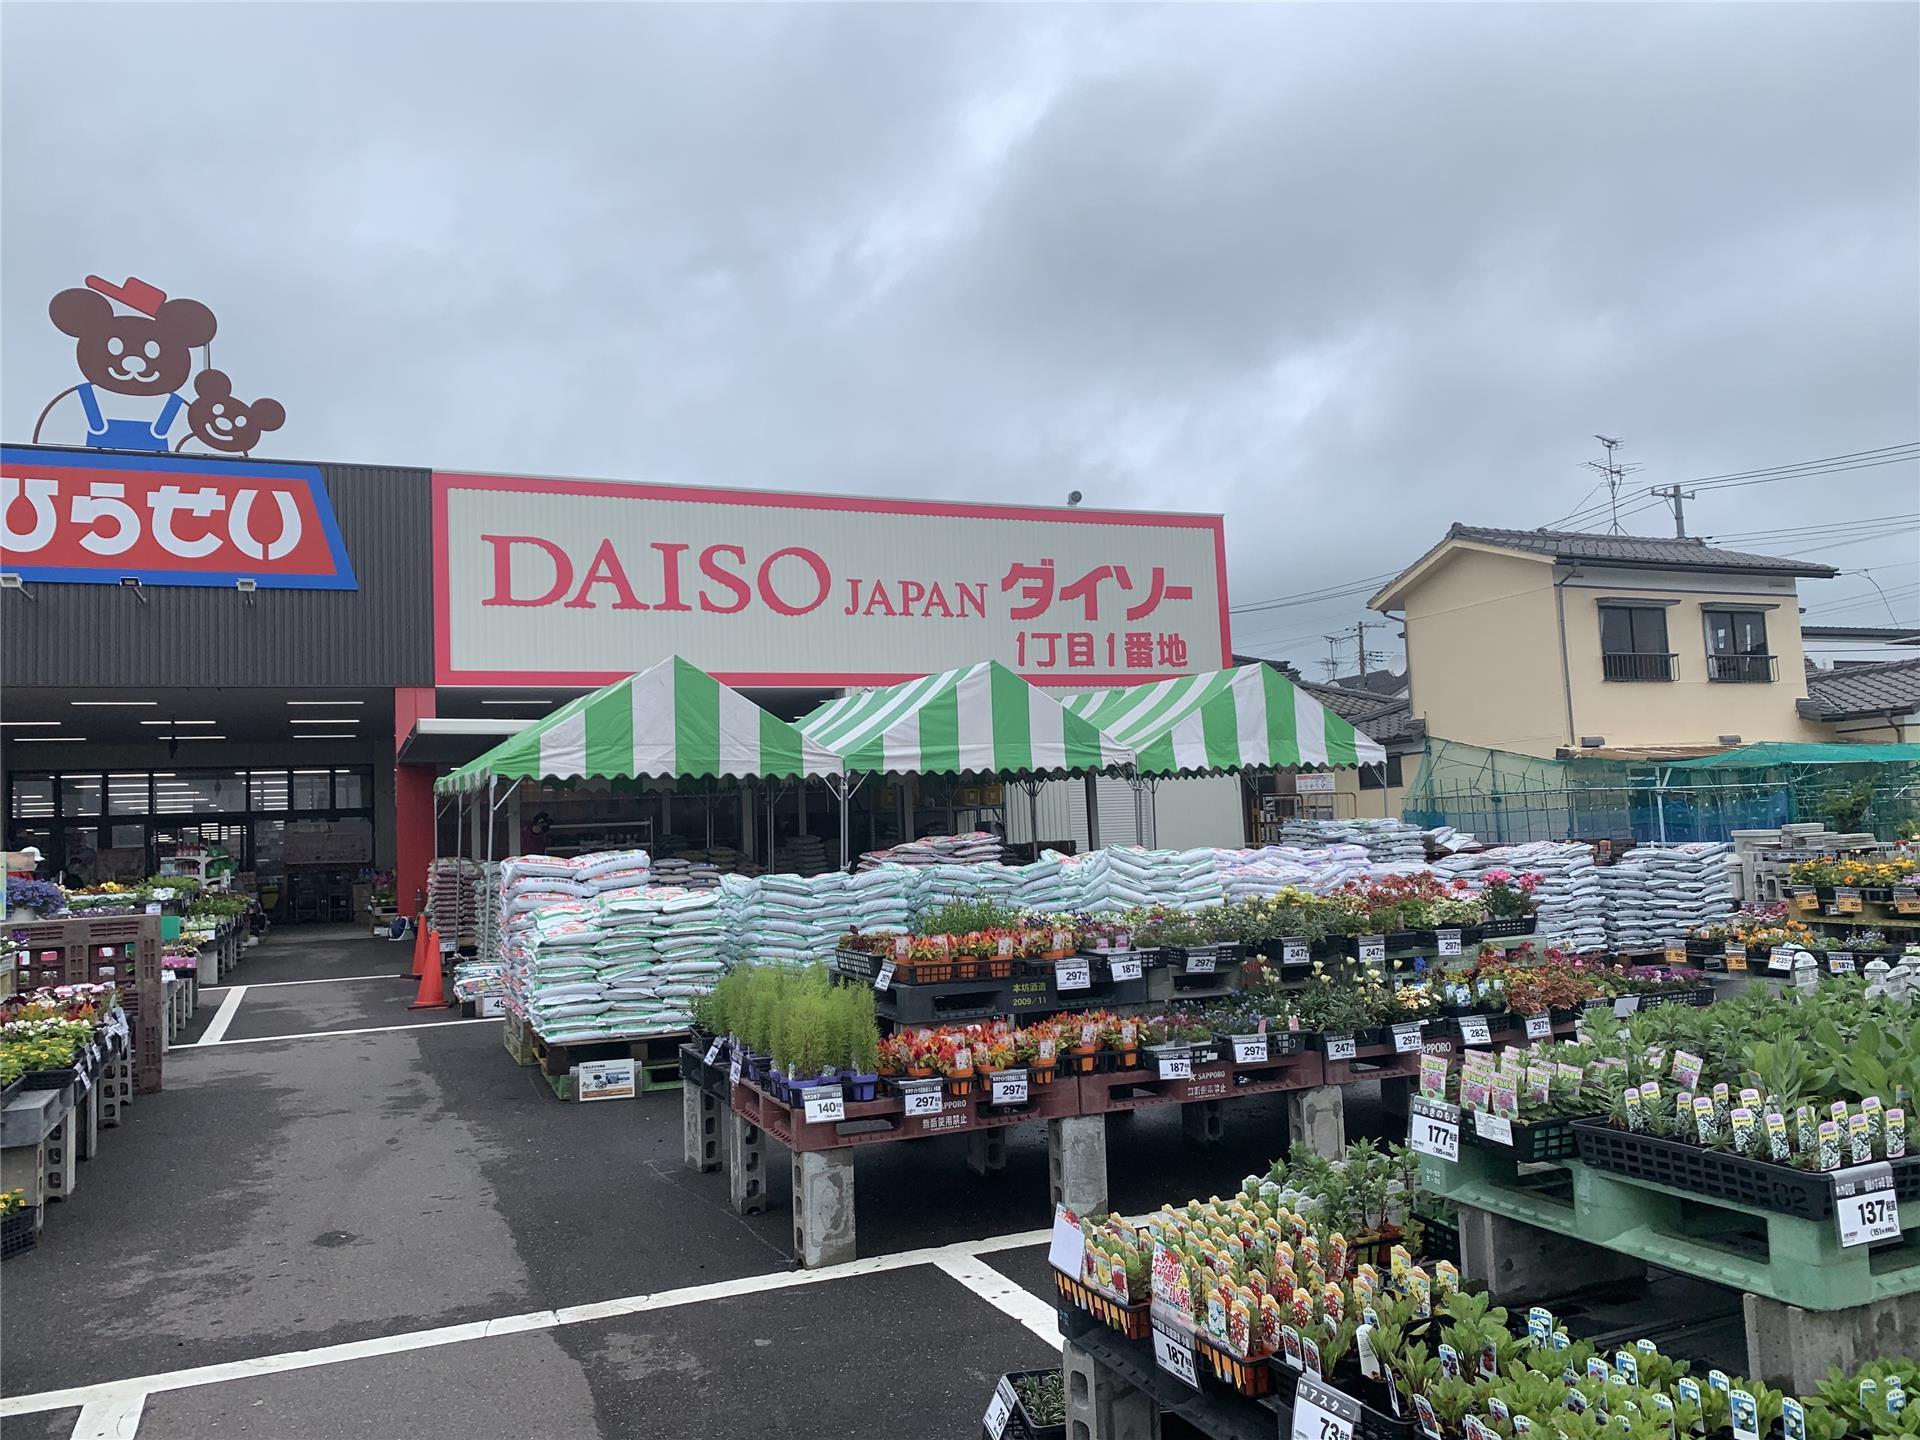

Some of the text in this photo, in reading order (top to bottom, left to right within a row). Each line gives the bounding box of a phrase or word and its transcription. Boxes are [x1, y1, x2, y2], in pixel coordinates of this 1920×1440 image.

[0, 478, 302, 561] ひらせい
[481, 534, 1193, 622] DAISO JAPAN ダイソー
[1017, 631, 1188, 668] 1丁目1番地
[1291, 948, 1304, 957] 247
[1366, 948, 1380, 956] 247
[1195, 958, 1210, 967] 297
[1122, 964, 1135, 973] 187
[1066, 971, 1082, 981] 297
[1533, 1021, 1545, 1030] 297
[1470, 1028, 1484, 1038] 282
[1402, 1035, 1417, 1045] 297
[1244, 1046, 1260, 1056] 297
[1335, 1043, 1350, 1053] 247
[1169, 1063, 1184, 1073] 187
[1198, 1071, 1226, 1081] SAPPORO
[1003, 1084, 1020, 1095] 297
[818, 1102, 836, 1113] 140
[915, 1097, 934, 1108] 297
[1422, 1106, 1458, 1123] かきのもと
[1428, 1125, 1449, 1145] 177
[1858, 1199, 1885, 1225] 137
[1166, 1343, 1185, 1368] 187
[1310, 1388, 1350, 1415] アスター
[1319, 1416, 1340, 1440] 73
